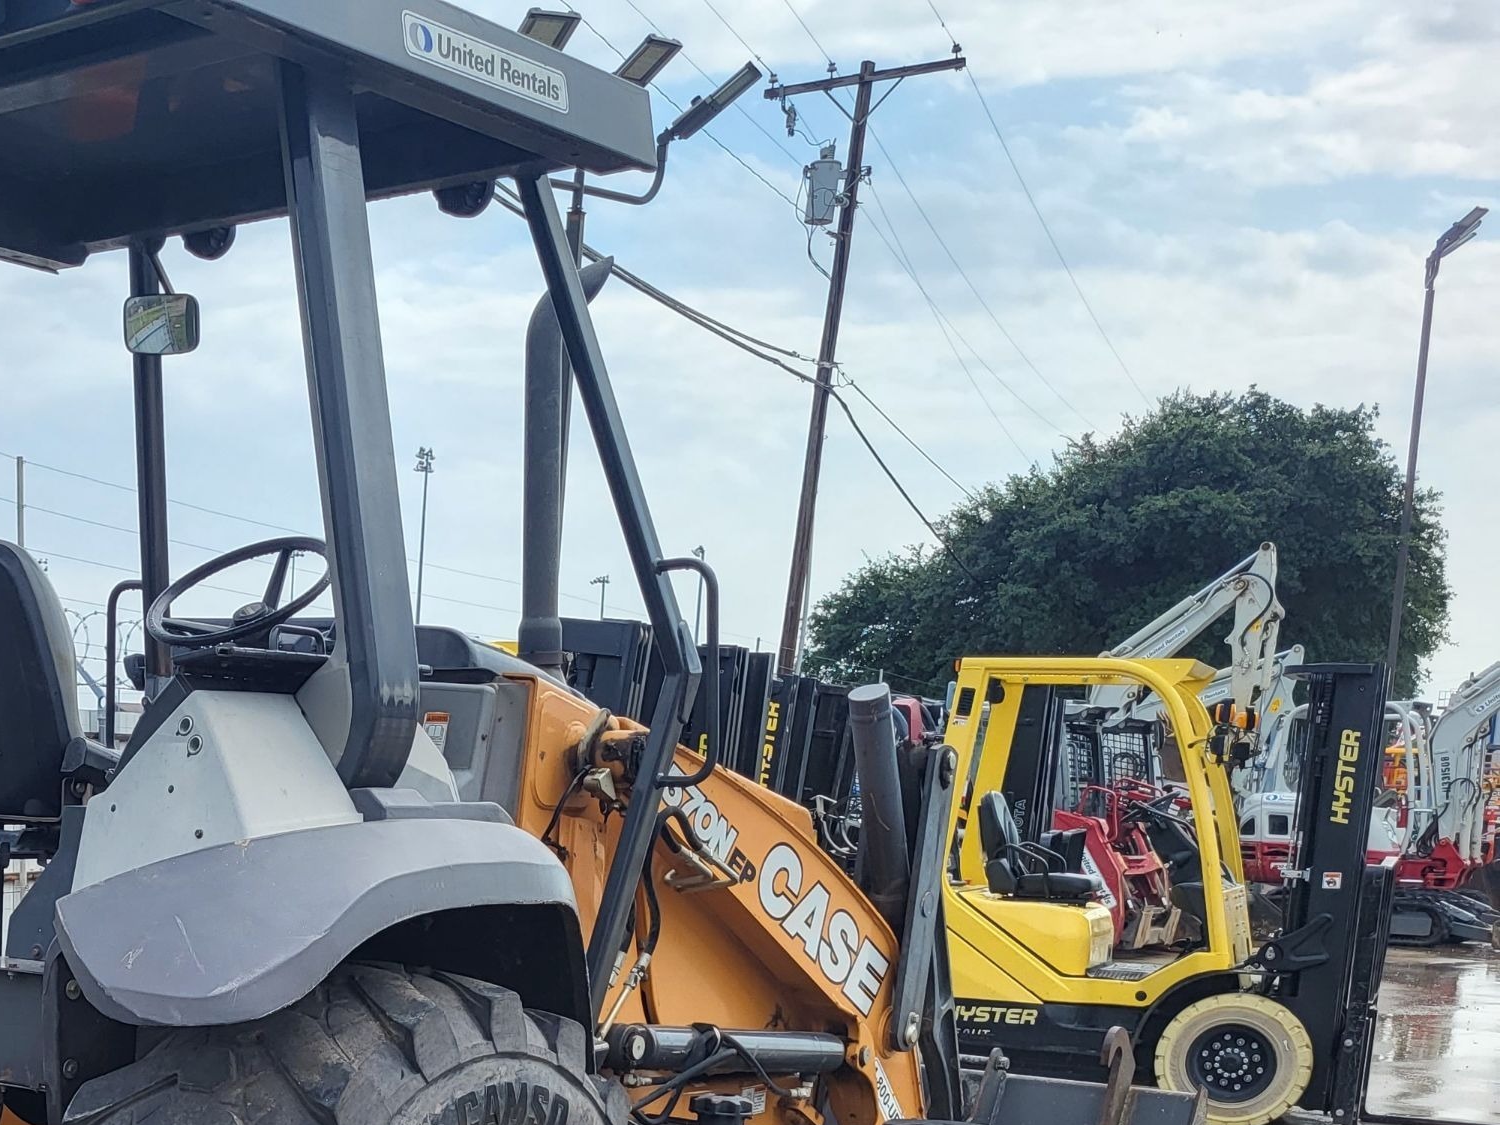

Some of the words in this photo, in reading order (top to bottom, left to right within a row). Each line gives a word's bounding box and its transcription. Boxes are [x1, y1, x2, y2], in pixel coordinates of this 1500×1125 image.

[437, 33, 495, 77] United
[500, 58, 560, 101] Rentals
[1146, 642, 1165, 659] United
[1165, 629, 1186, 646] Rentals
[1330, 729, 1361, 825] HYSTER
[728, 846, 758, 884] EP
[758, 841, 891, 1019] CASE
